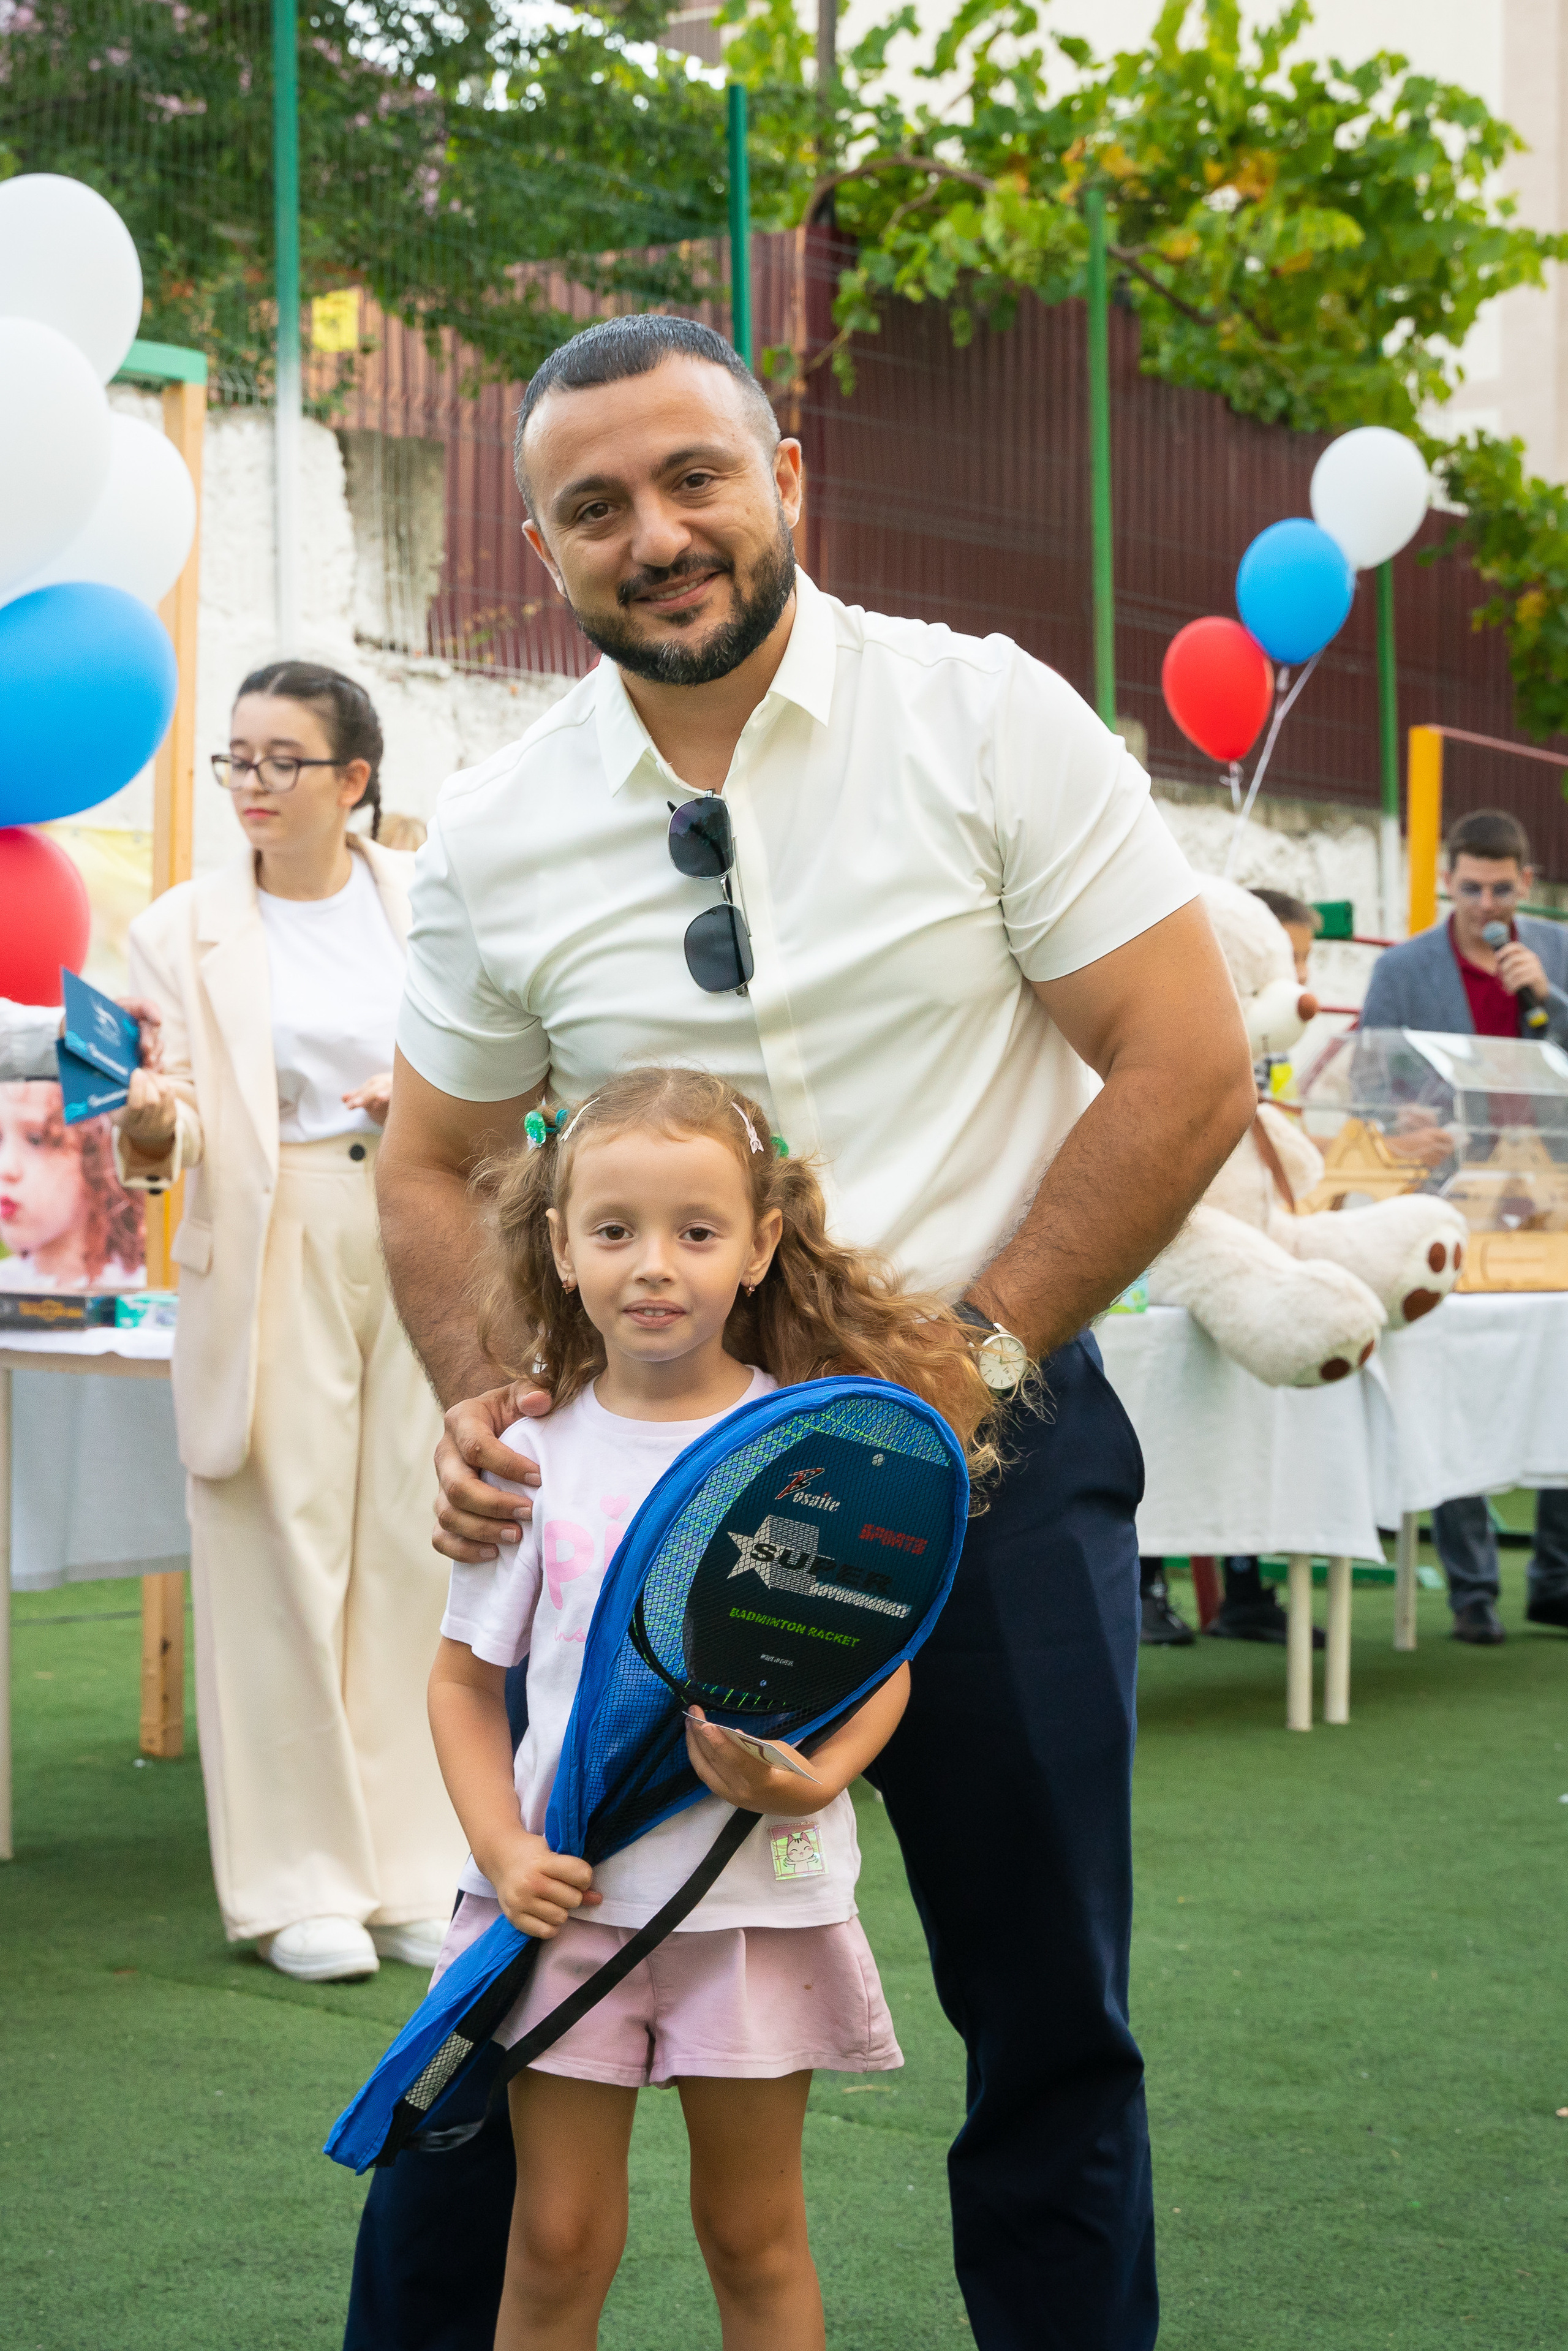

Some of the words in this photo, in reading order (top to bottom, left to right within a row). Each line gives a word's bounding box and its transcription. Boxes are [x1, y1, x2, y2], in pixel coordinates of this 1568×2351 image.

[858, 1523, 928, 1555] SPORTS
[750, 1542, 893, 1594] SUPER
[729, 1607, 807, 1634] BADMINTON
[808, 1626, 861, 1647] RACKET
